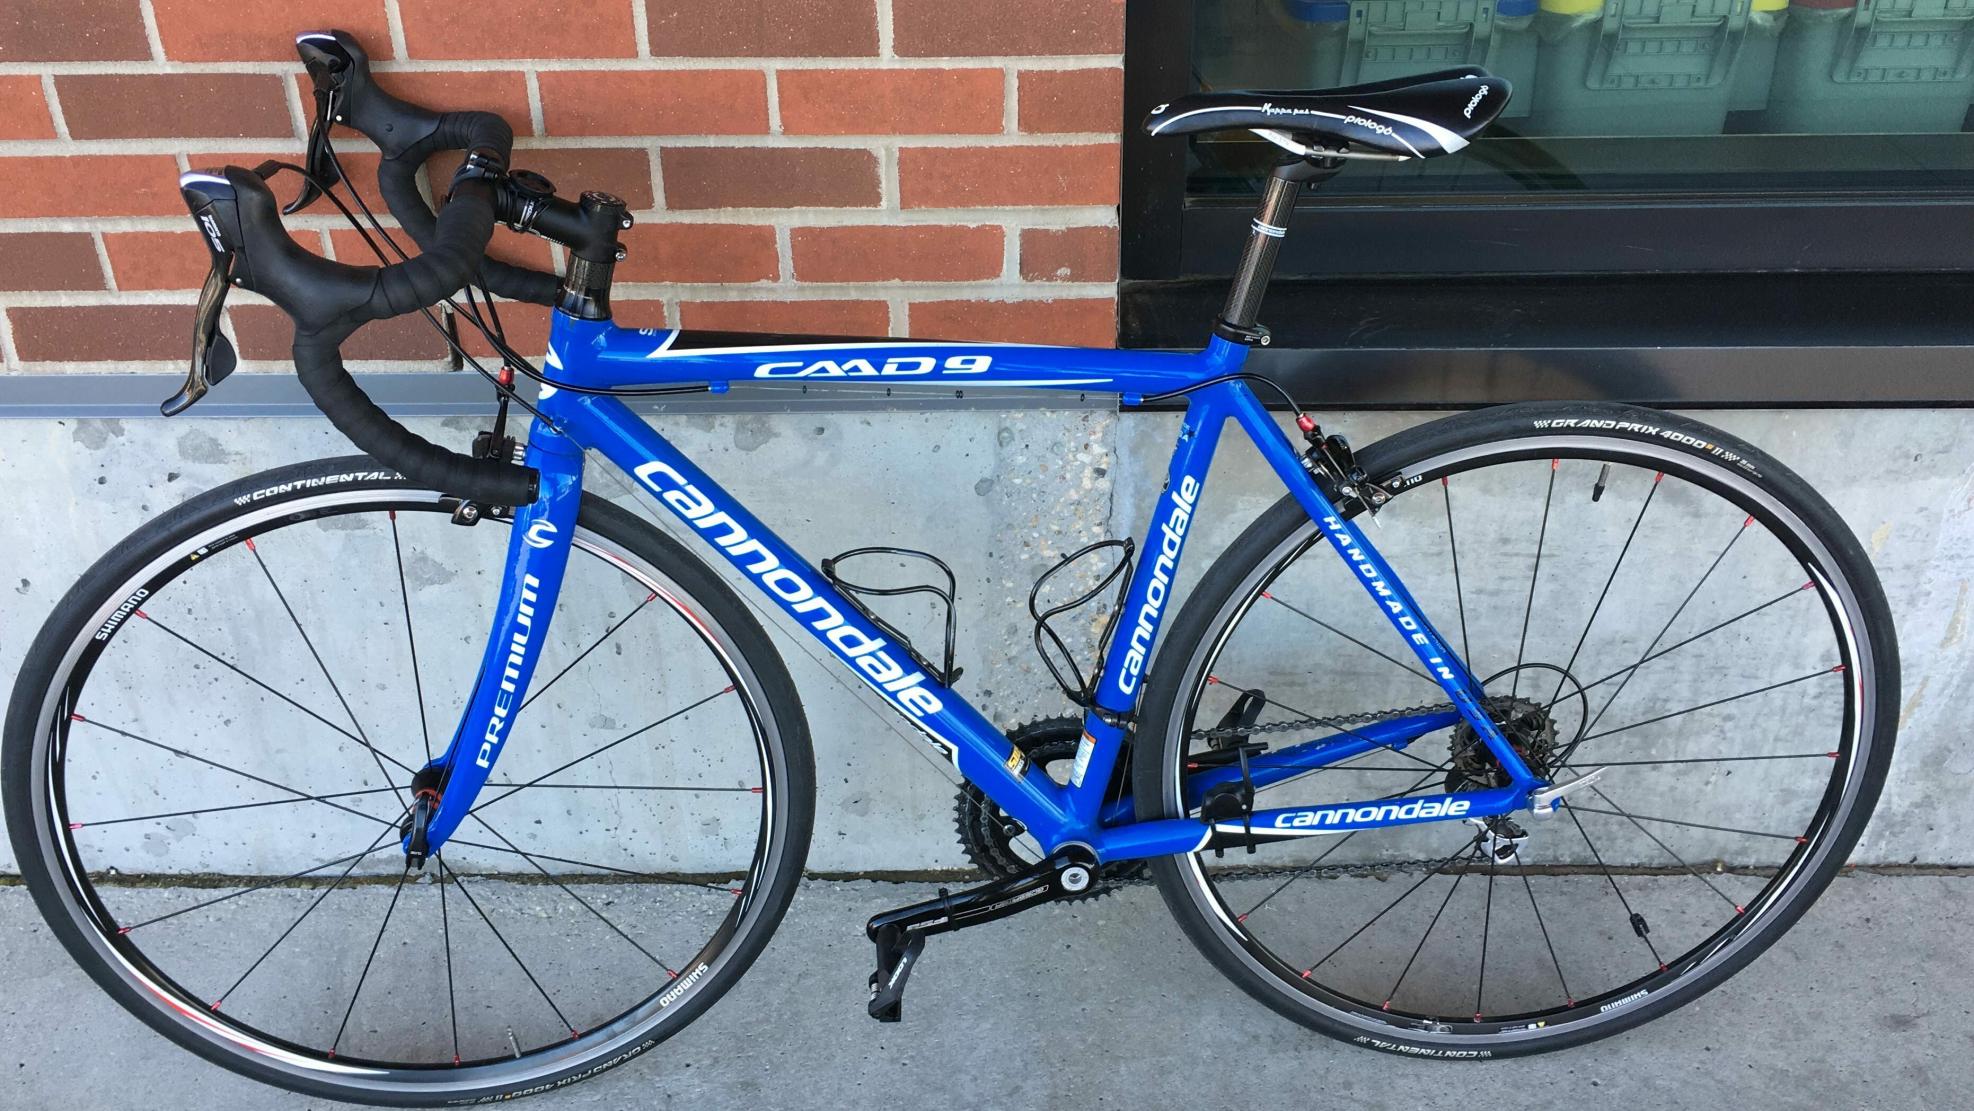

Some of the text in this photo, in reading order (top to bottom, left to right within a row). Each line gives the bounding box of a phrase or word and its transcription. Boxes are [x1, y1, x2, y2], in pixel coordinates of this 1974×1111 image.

[200, 215, 225, 252] 105
[753, 355, 993, 378] CAAD 9
[1550, 418, 1616, 429] GRAND
[1615, 421, 1659, 436] PRIX
[252, 471, 391, 501] CONTINENTAL
[634, 460, 944, 717] cannondale
[1118, 474, 1200, 696] cannondale
[1323, 515, 1455, 680] HANDMADE IN
[95, 588, 150, 641] SHIMANO
[476, 573, 540, 769] PREMIUM
[1274, 797, 1471, 829] cannondale
[659, 961, 709, 1007] SHIMANO
[888, 956, 908, 990] LOOK
[1600, 989, 1649, 1013] SHIMANO
[1371, 1039, 1479, 1058] CONTINENTAL
